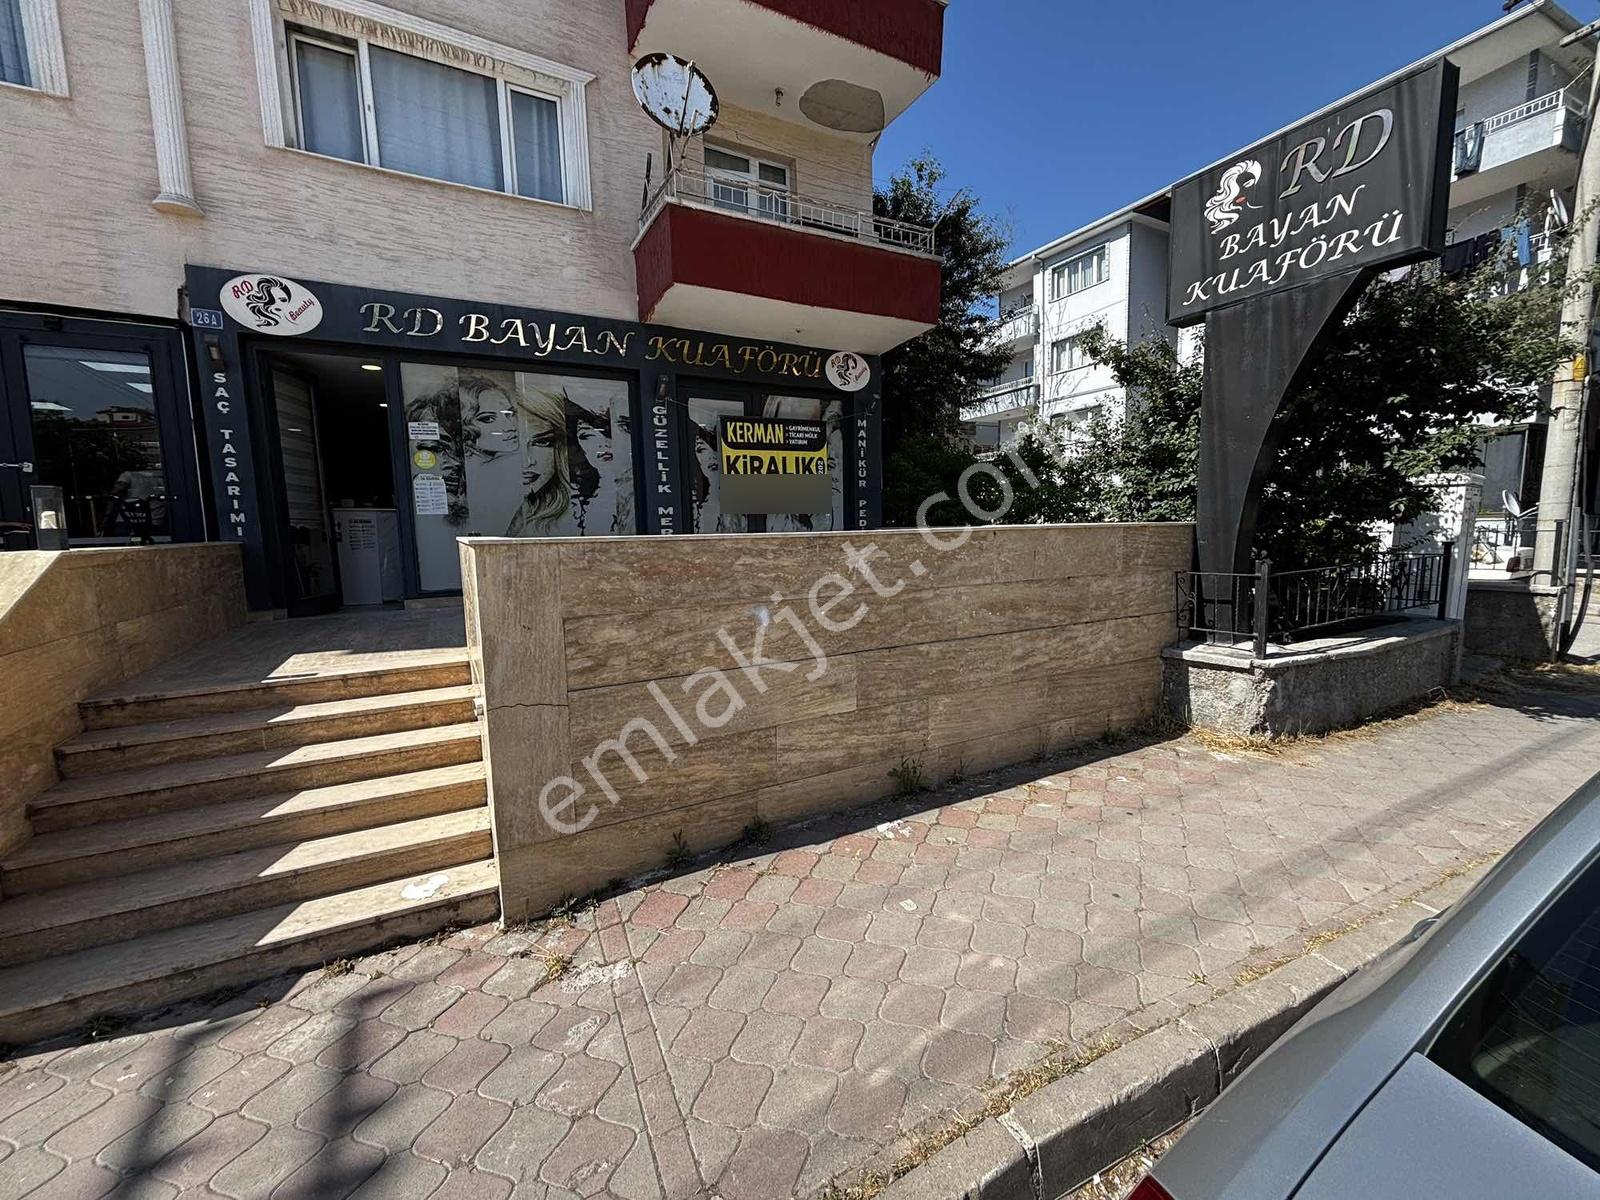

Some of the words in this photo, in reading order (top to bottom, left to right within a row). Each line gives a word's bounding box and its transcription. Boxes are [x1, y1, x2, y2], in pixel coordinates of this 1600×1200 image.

[1279, 108, 1394, 200] RD
[1183, 210, 1403, 306] KUAFÖRÜ
[1219, 184, 1365, 260] BAYAN
[231, 280, 254, 299] RD
[359, 302, 444, 337] RD
[458, 314, 635, 357] BAYAN
[645, 336, 822, 379] KUAFÖRÜ
[213, 372, 230, 414] SAÇ
[652, 405, 672, 493] GÜZELLİK
[726, 421, 784, 444] KERMAN
[857, 419, 867, 488] MANİKÜR
[220, 429, 245, 536] TASARIMI
[859, 499, 867, 530] PED
